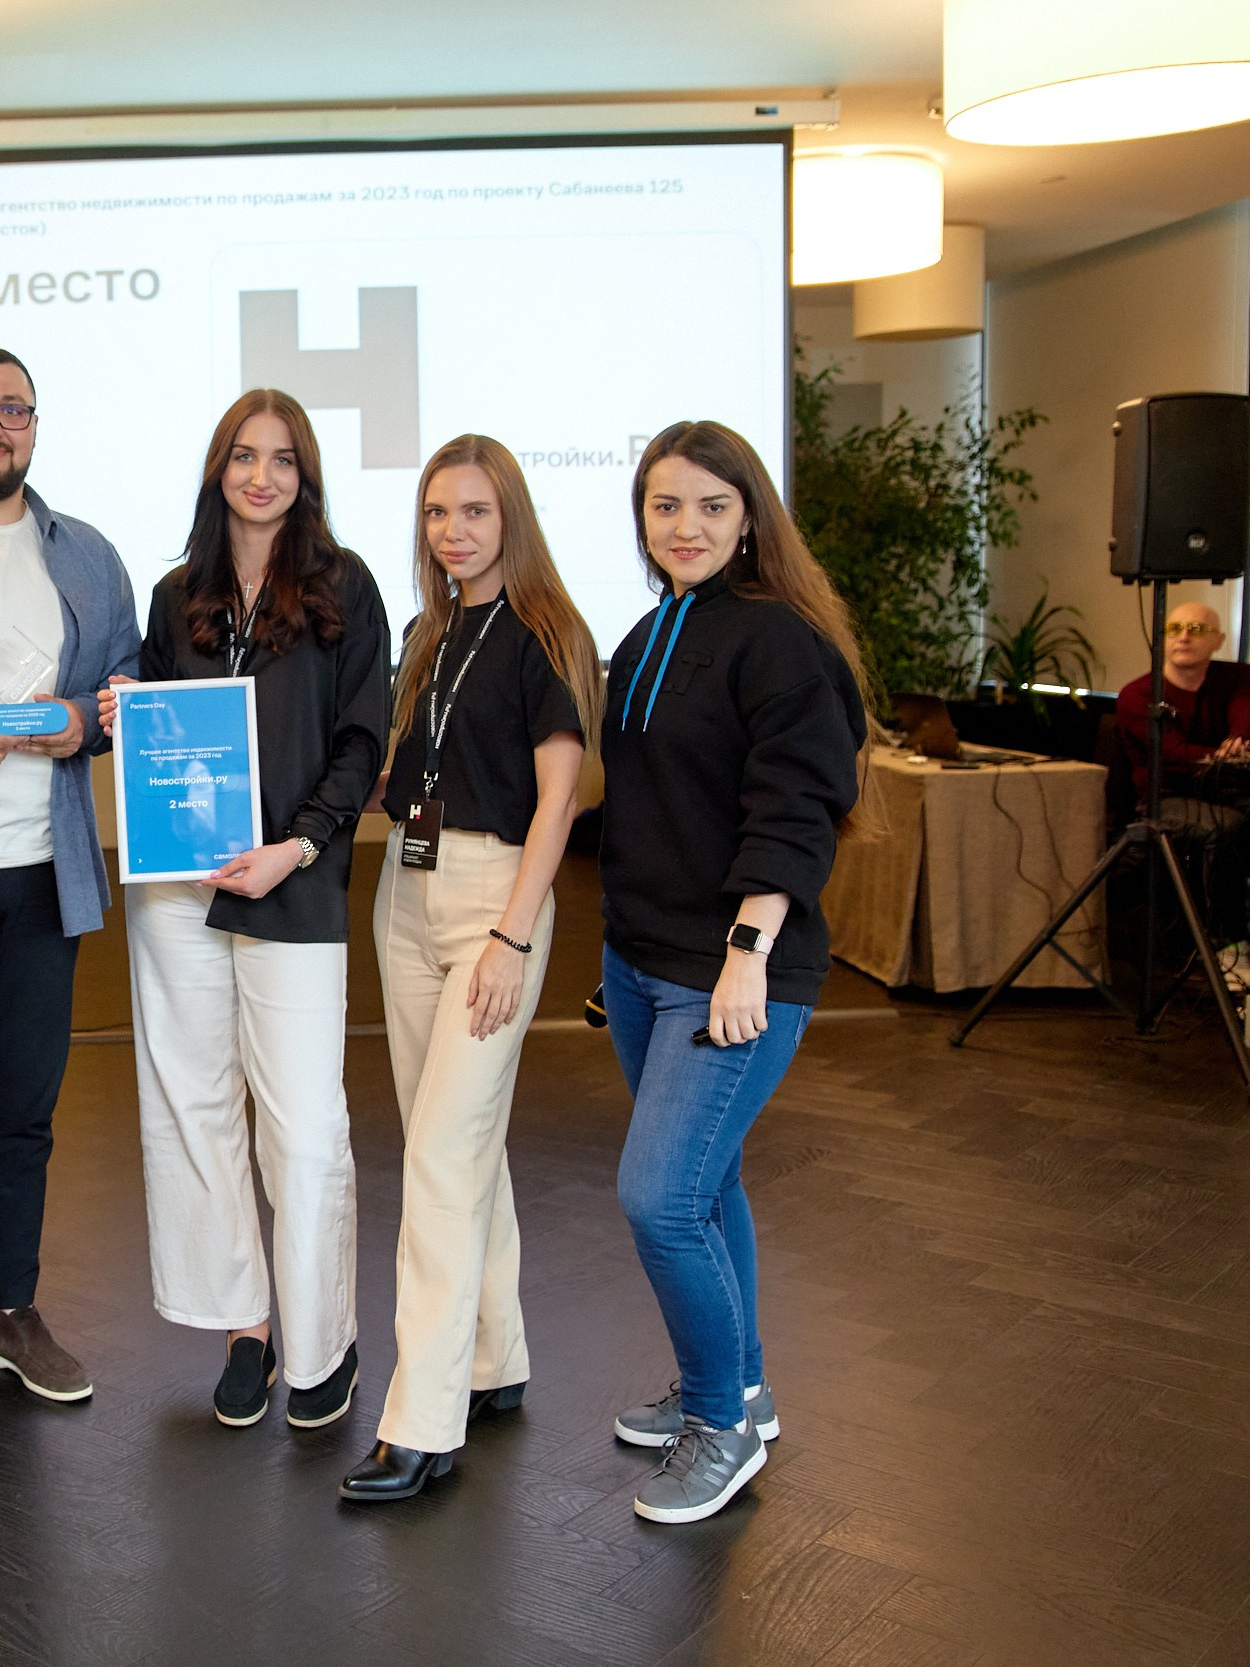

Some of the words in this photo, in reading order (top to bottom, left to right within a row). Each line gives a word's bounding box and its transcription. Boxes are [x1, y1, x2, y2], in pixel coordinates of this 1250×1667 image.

[81, 193, 212, 212] недвижимости
[217, 193, 237, 206] по
[242, 190, 332, 207] продажам
[338, 190, 356, 202] за
[361, 186, 410, 202] 2023
[414, 186, 444, 201] год
[448, 187, 469, 199] по
[473, 185, 544, 201] проекту
[549, 181, 644, 197] Сабанеева
[650, 179, 684, 195] 125
[517, 434, 650, 468] ТРОЙКИ.Р
[154, 702, 165, 710] Day
[149, 775, 228, 787] Новостройки.ру
[169, 800, 177, 809] 2
[178, 800, 208, 809] место
